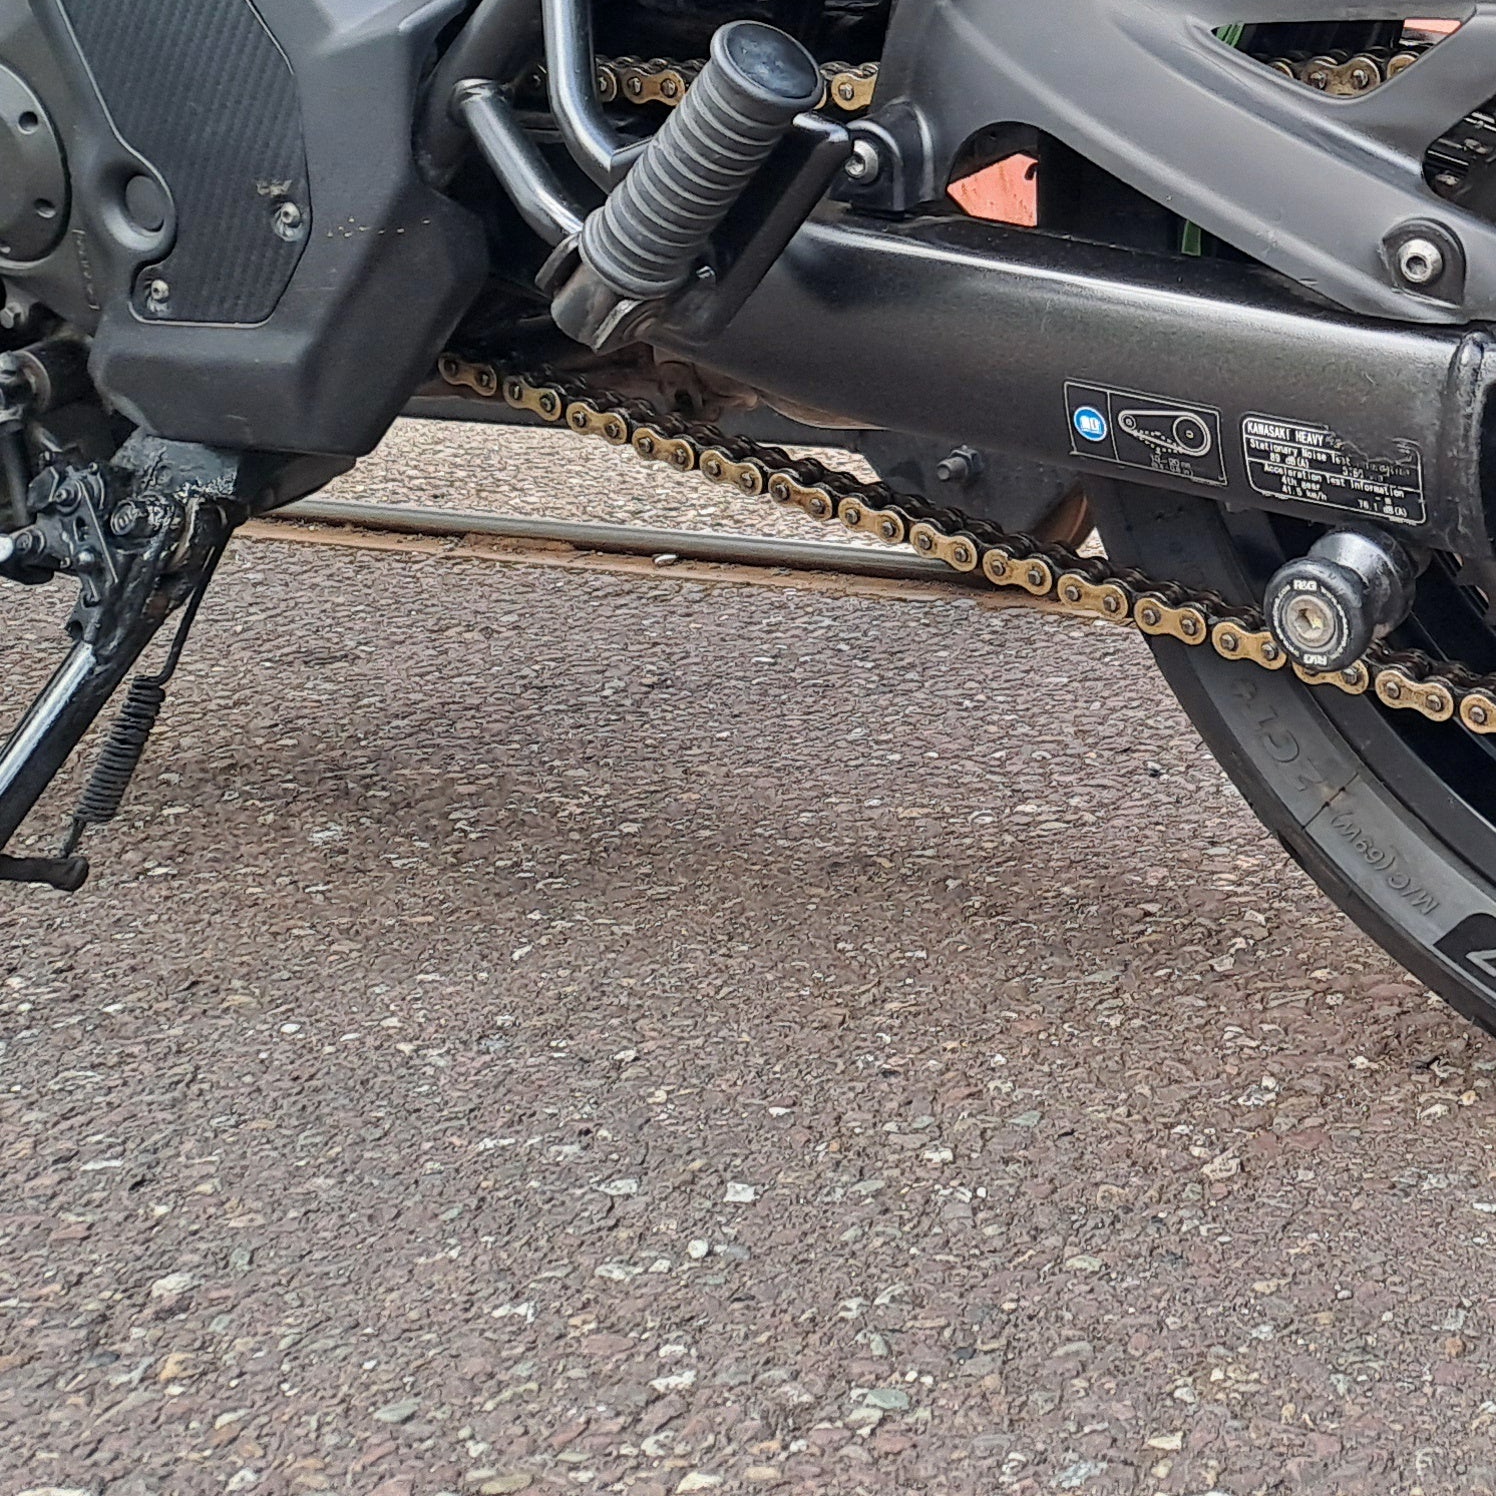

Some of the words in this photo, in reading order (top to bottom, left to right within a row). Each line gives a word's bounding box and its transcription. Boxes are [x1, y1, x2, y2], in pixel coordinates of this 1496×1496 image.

[1247, 421, 1291, 441] KAWASAKI
[1295, 430, 1324, 447] HEAVY
[1350, 477, 1405, 499] Information
